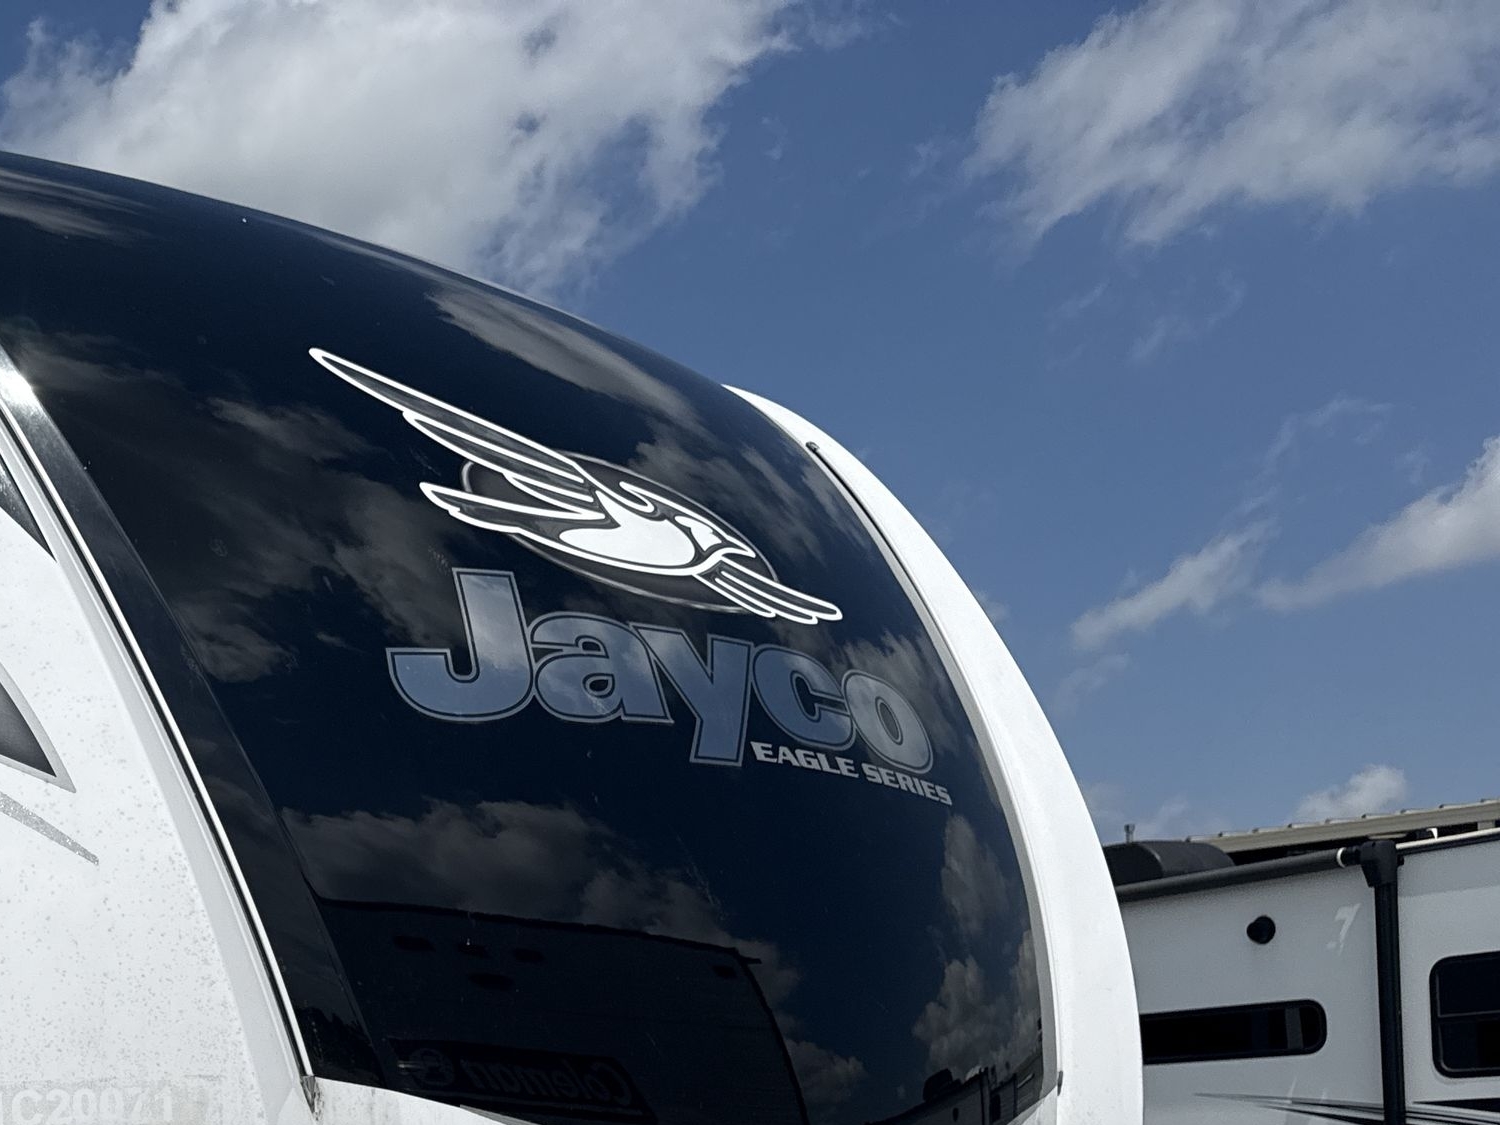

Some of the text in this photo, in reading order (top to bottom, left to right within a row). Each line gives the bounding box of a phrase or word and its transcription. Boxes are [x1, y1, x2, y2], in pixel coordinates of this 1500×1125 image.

[385, 567, 933, 774] Jayco
[750, 741, 953, 806] EAGLE SERIES
